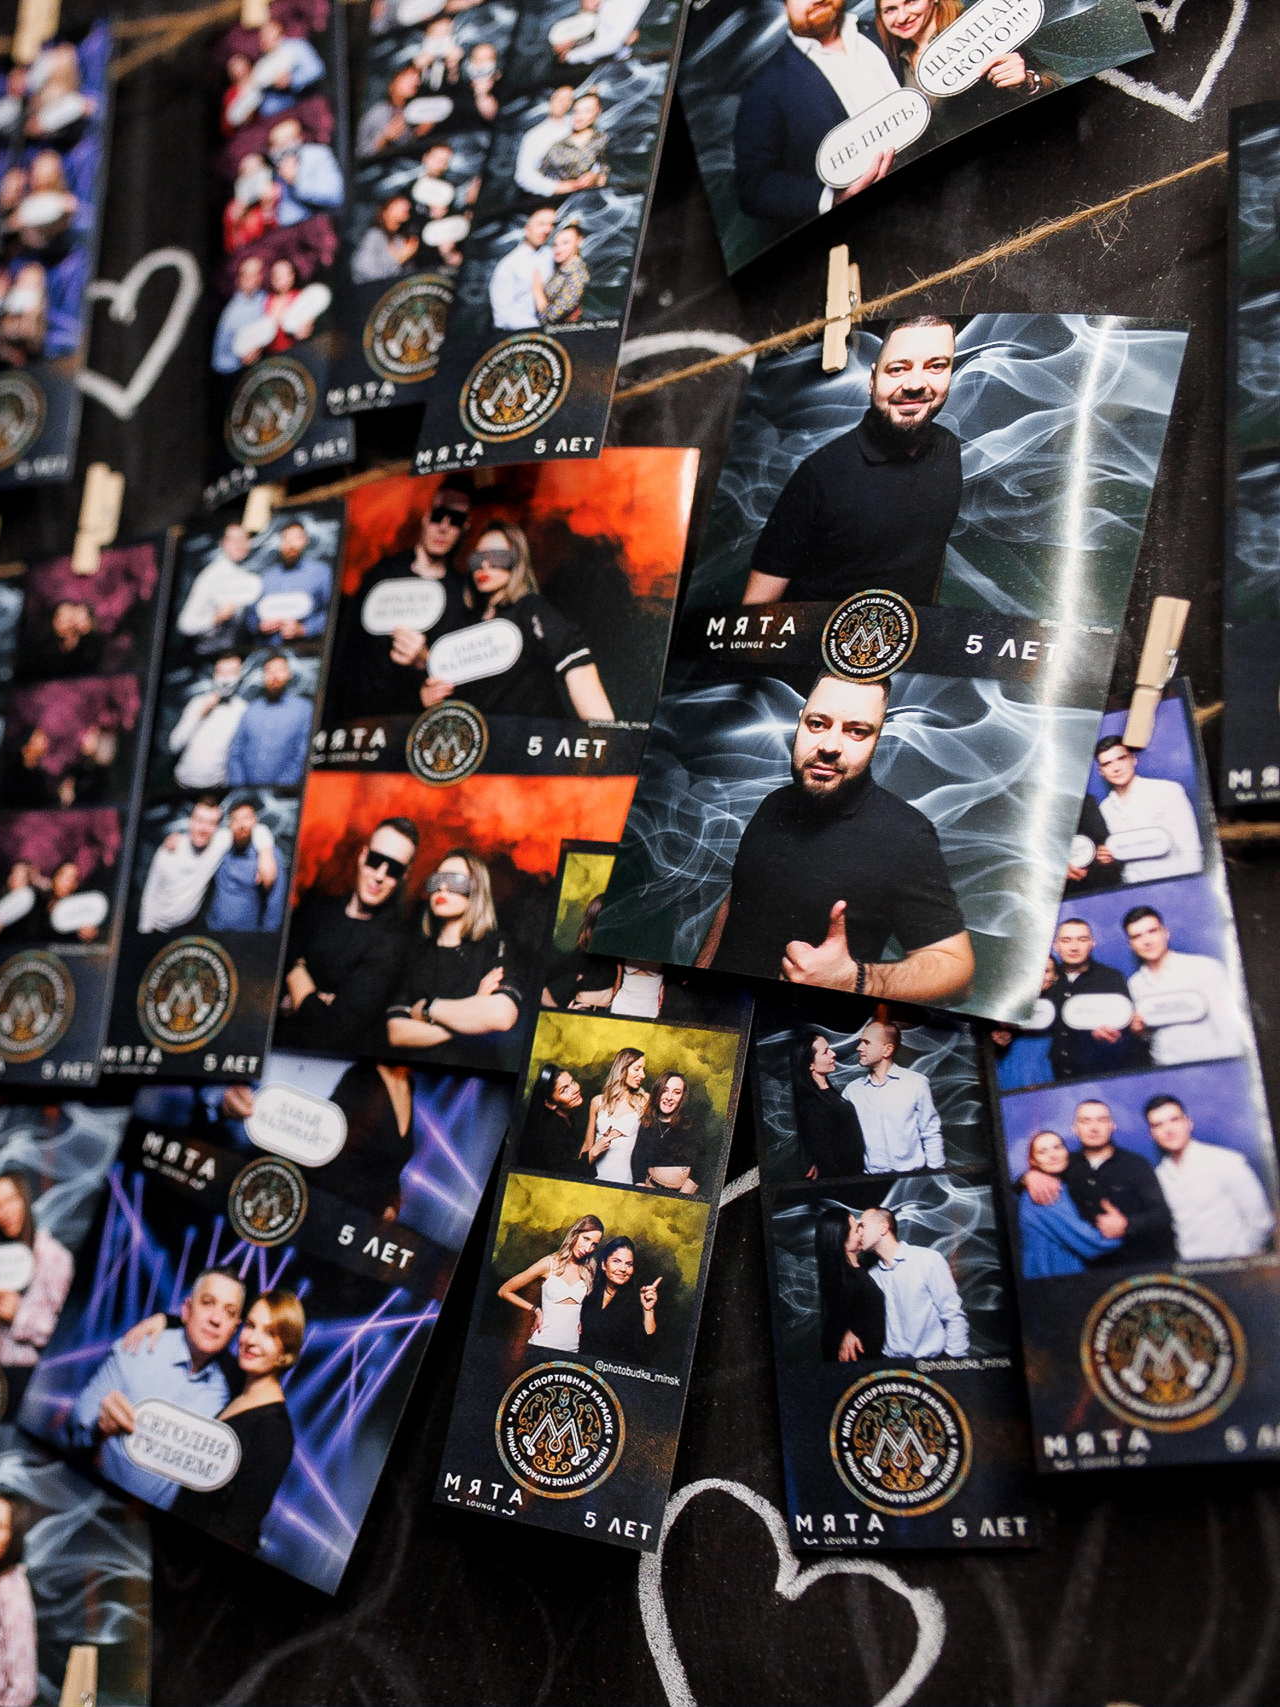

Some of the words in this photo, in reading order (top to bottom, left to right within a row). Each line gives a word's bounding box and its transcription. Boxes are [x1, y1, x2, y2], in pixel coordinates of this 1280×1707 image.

[829, 142, 858, 169] НЕ
[862, 102, 919, 147] ПИТЬ!
[416, 441, 484, 466] МЯТА
[534, 438, 547, 454] 5
[555, 436, 595, 452] ЛЕТ
[706, 616, 796, 637] МЯТА
[964, 634, 984, 655] 5
[997, 638, 1062, 663] ЛЕТ
[730, 641, 764, 649] LOUNGE
[527, 736, 542, 757] 5
[555, 737, 608, 759] ЛЕТ
[337, 1224, 356, 1246] 5
[362, 1237, 415, 1269] ЛЕТ
[595, 1360, 680, 1387] @photobudka_minsk
[510, 1389, 529, 1414] МЯТА
[528, 1374, 592, 1393] СПОРТИВНАЯ
[590, 1390, 614, 1435] КАРАОКЕ
[506, 1426, 522, 1462] СТРАНЫ
[1043, 1427, 1152, 1458] МЯТА
[1256, 1423, 1280, 1450] Л
[518, 1459, 552, 1485] КАРАОКЕ
[585, 1446, 610, 1476] ПЕРВОЕ
[551, 1472, 587, 1486] МЯТНОЕ
[444, 1473, 523, 1506] МЯТА
[583, 1511, 597, 1528] 5
[607, 1517, 652, 1541] ЛЕТ
[466, 1499, 497, 1512] LOUNGE
[795, 1513, 885, 1532] МЯТА
[951, 1517, 968, 1538] 5
[980, 1516, 1029, 1537] ЛЕТ
